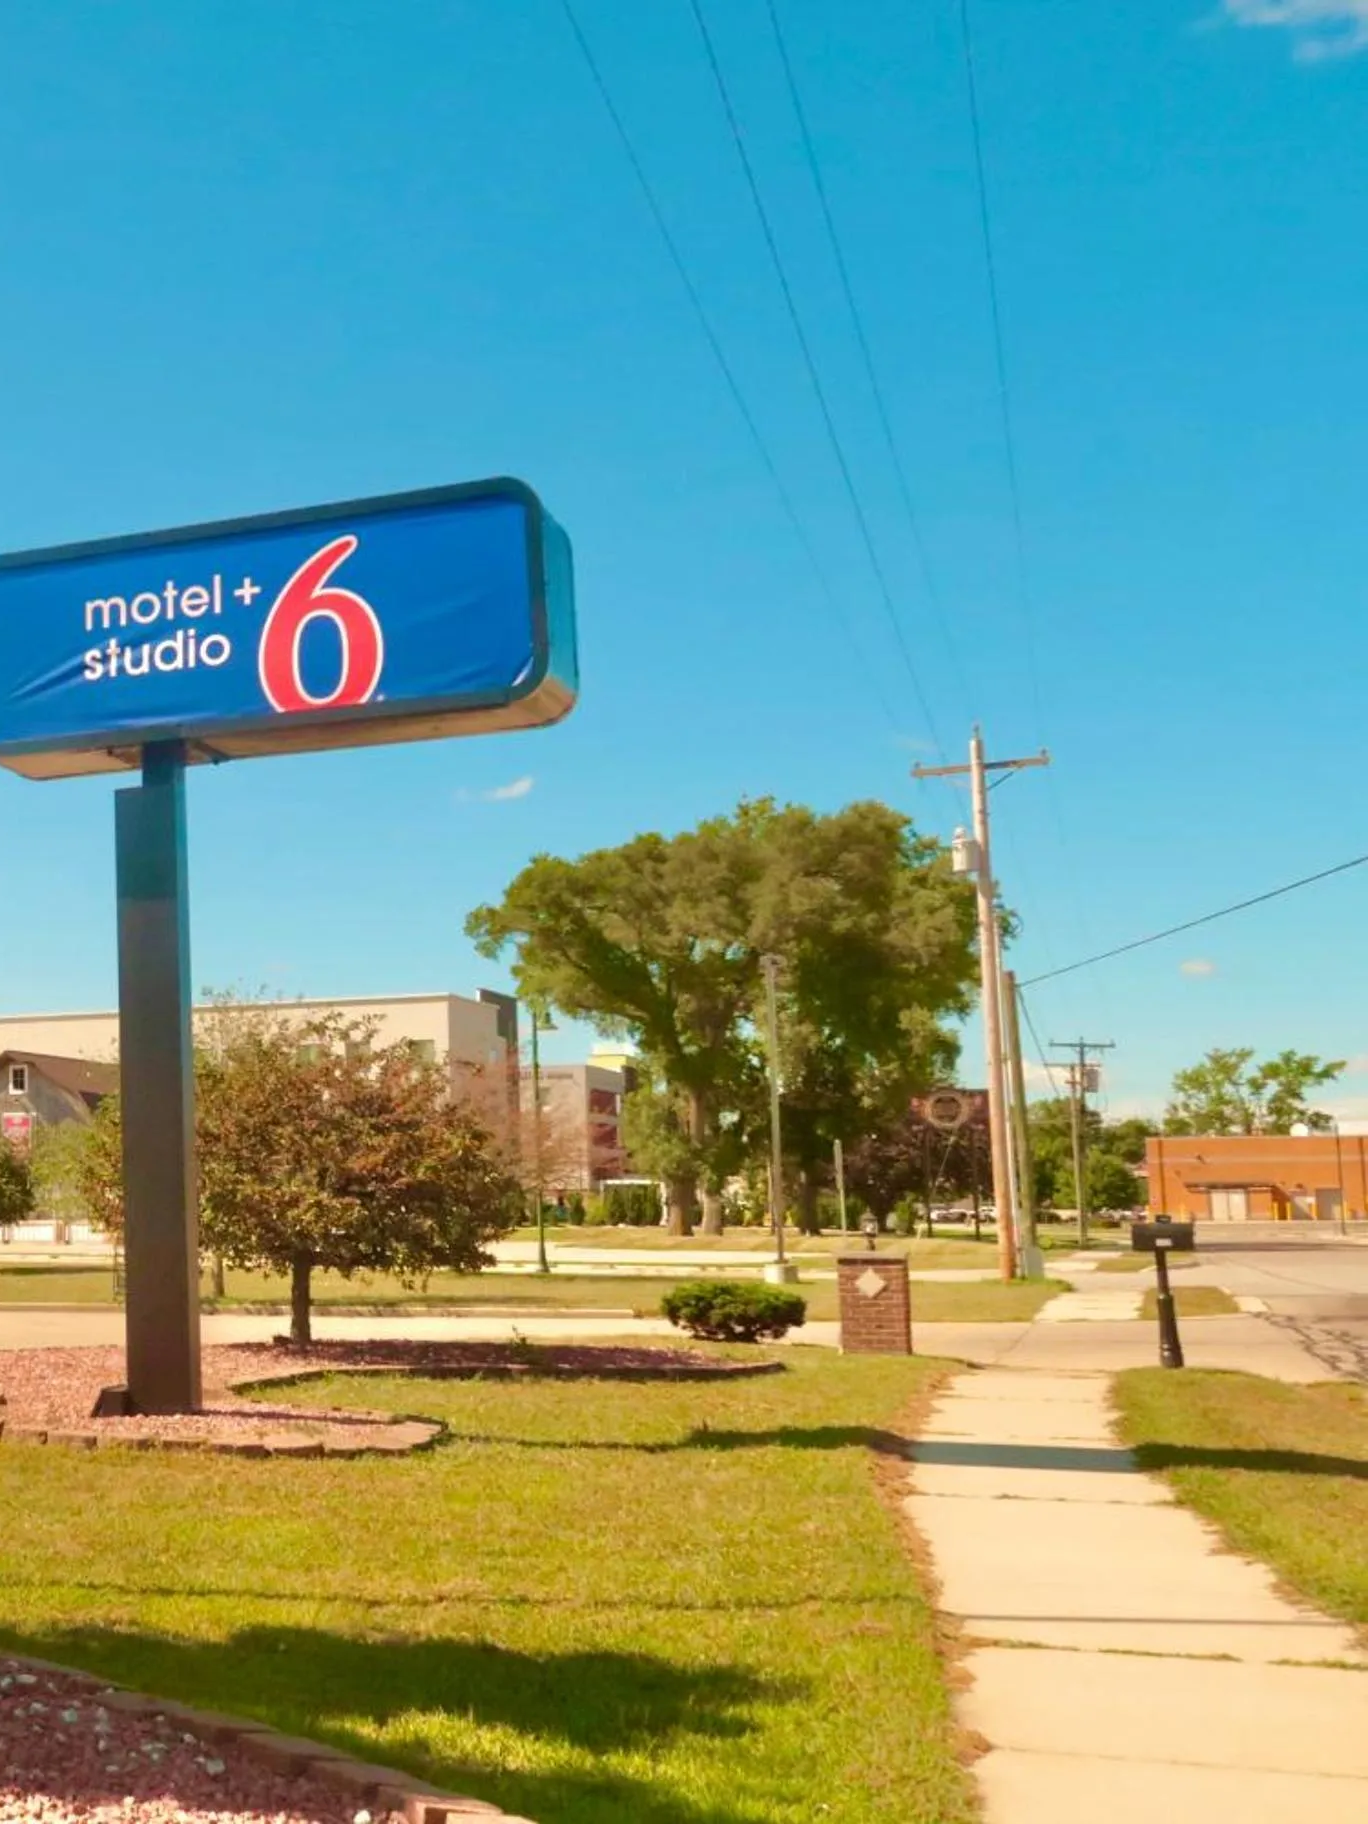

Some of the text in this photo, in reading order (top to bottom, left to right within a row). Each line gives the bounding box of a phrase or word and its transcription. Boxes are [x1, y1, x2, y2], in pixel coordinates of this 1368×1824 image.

[85, 574, 221, 631] motel
[258, 534, 384, 713] 6
[84, 628, 231, 681] studio
